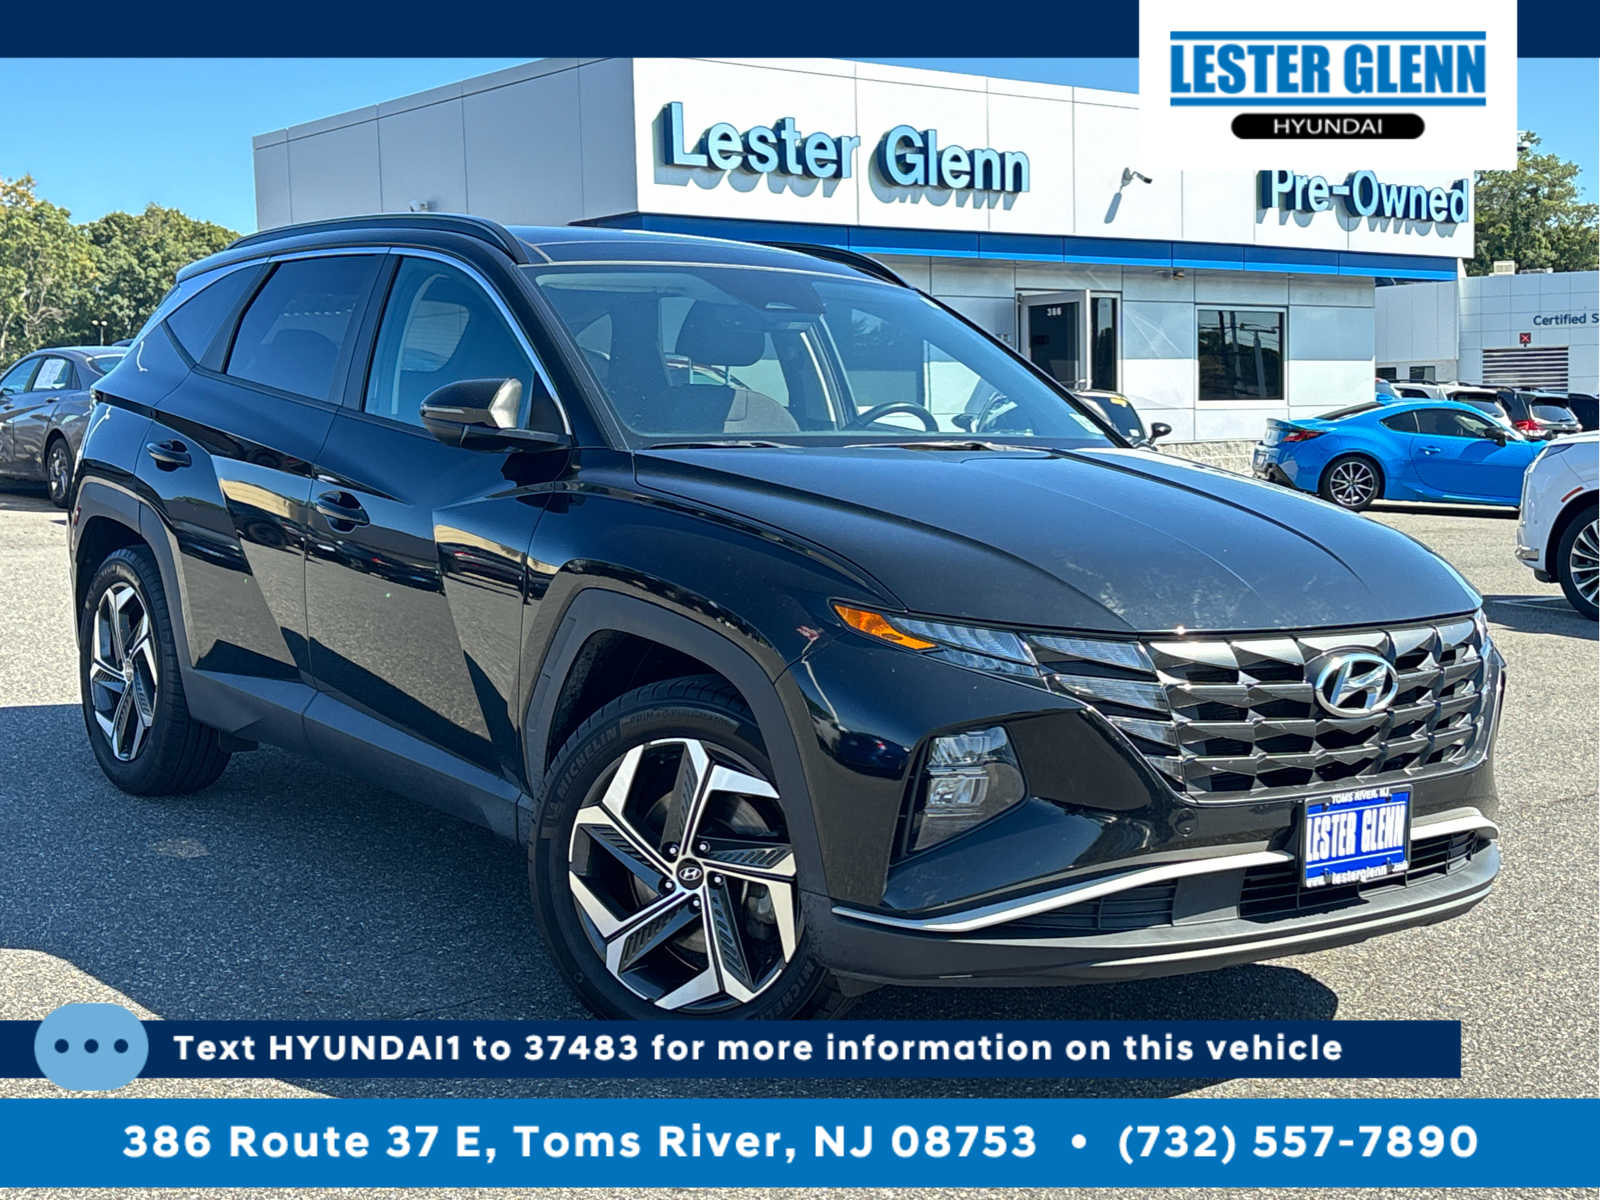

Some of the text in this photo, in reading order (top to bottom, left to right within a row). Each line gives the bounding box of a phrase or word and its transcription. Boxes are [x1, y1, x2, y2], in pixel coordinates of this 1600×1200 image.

[655, 101, 1031, 193] Lester Glenn
[1262, 169, 1469, 223] Pre-Owned
[1533, 313, 1587, 326] Certified
[557, 726, 618, 799] MICHELIN
[1306, 804, 1406, 863] LESTER GLENN
